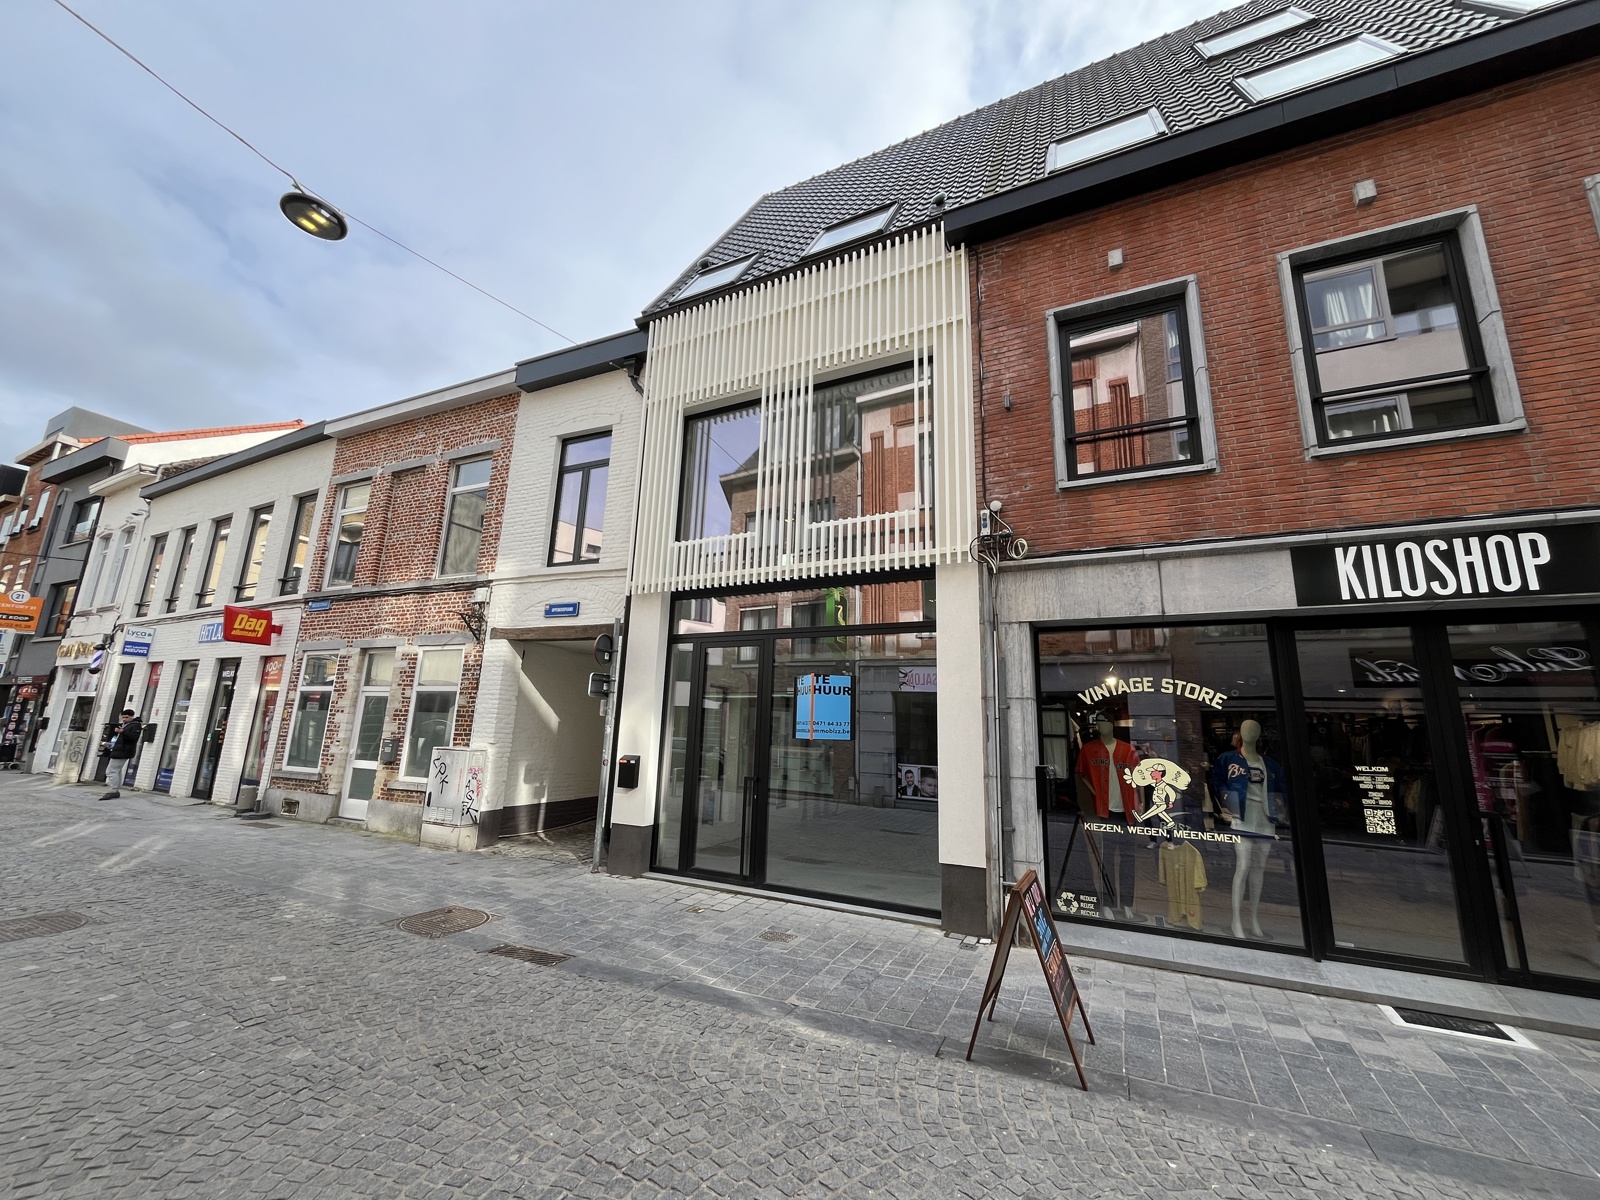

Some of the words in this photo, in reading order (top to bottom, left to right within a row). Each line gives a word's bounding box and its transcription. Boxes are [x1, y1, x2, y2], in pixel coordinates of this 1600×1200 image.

[1335, 532, 1551, 600] KILOSHOP
[127, 629, 147, 637] Lyca
[200, 623, 213, 642] HET
[231, 628, 258, 637] allemaal
[233, 613, 267, 638] Dag
[814, 675, 830, 685] TE
[813, 685, 852, 696] HUUR
[1077, 677, 1154, 705] VINTAGE
[1160, 678, 1228, 710] STORE
[1084, 822, 1124, 835] KIEZEN,
[1127, 825, 1170, 839] WEGEN,
[1173, 830, 1241, 844] MEENEMEN
[1080, 909, 1100, 918] RECYCLE
